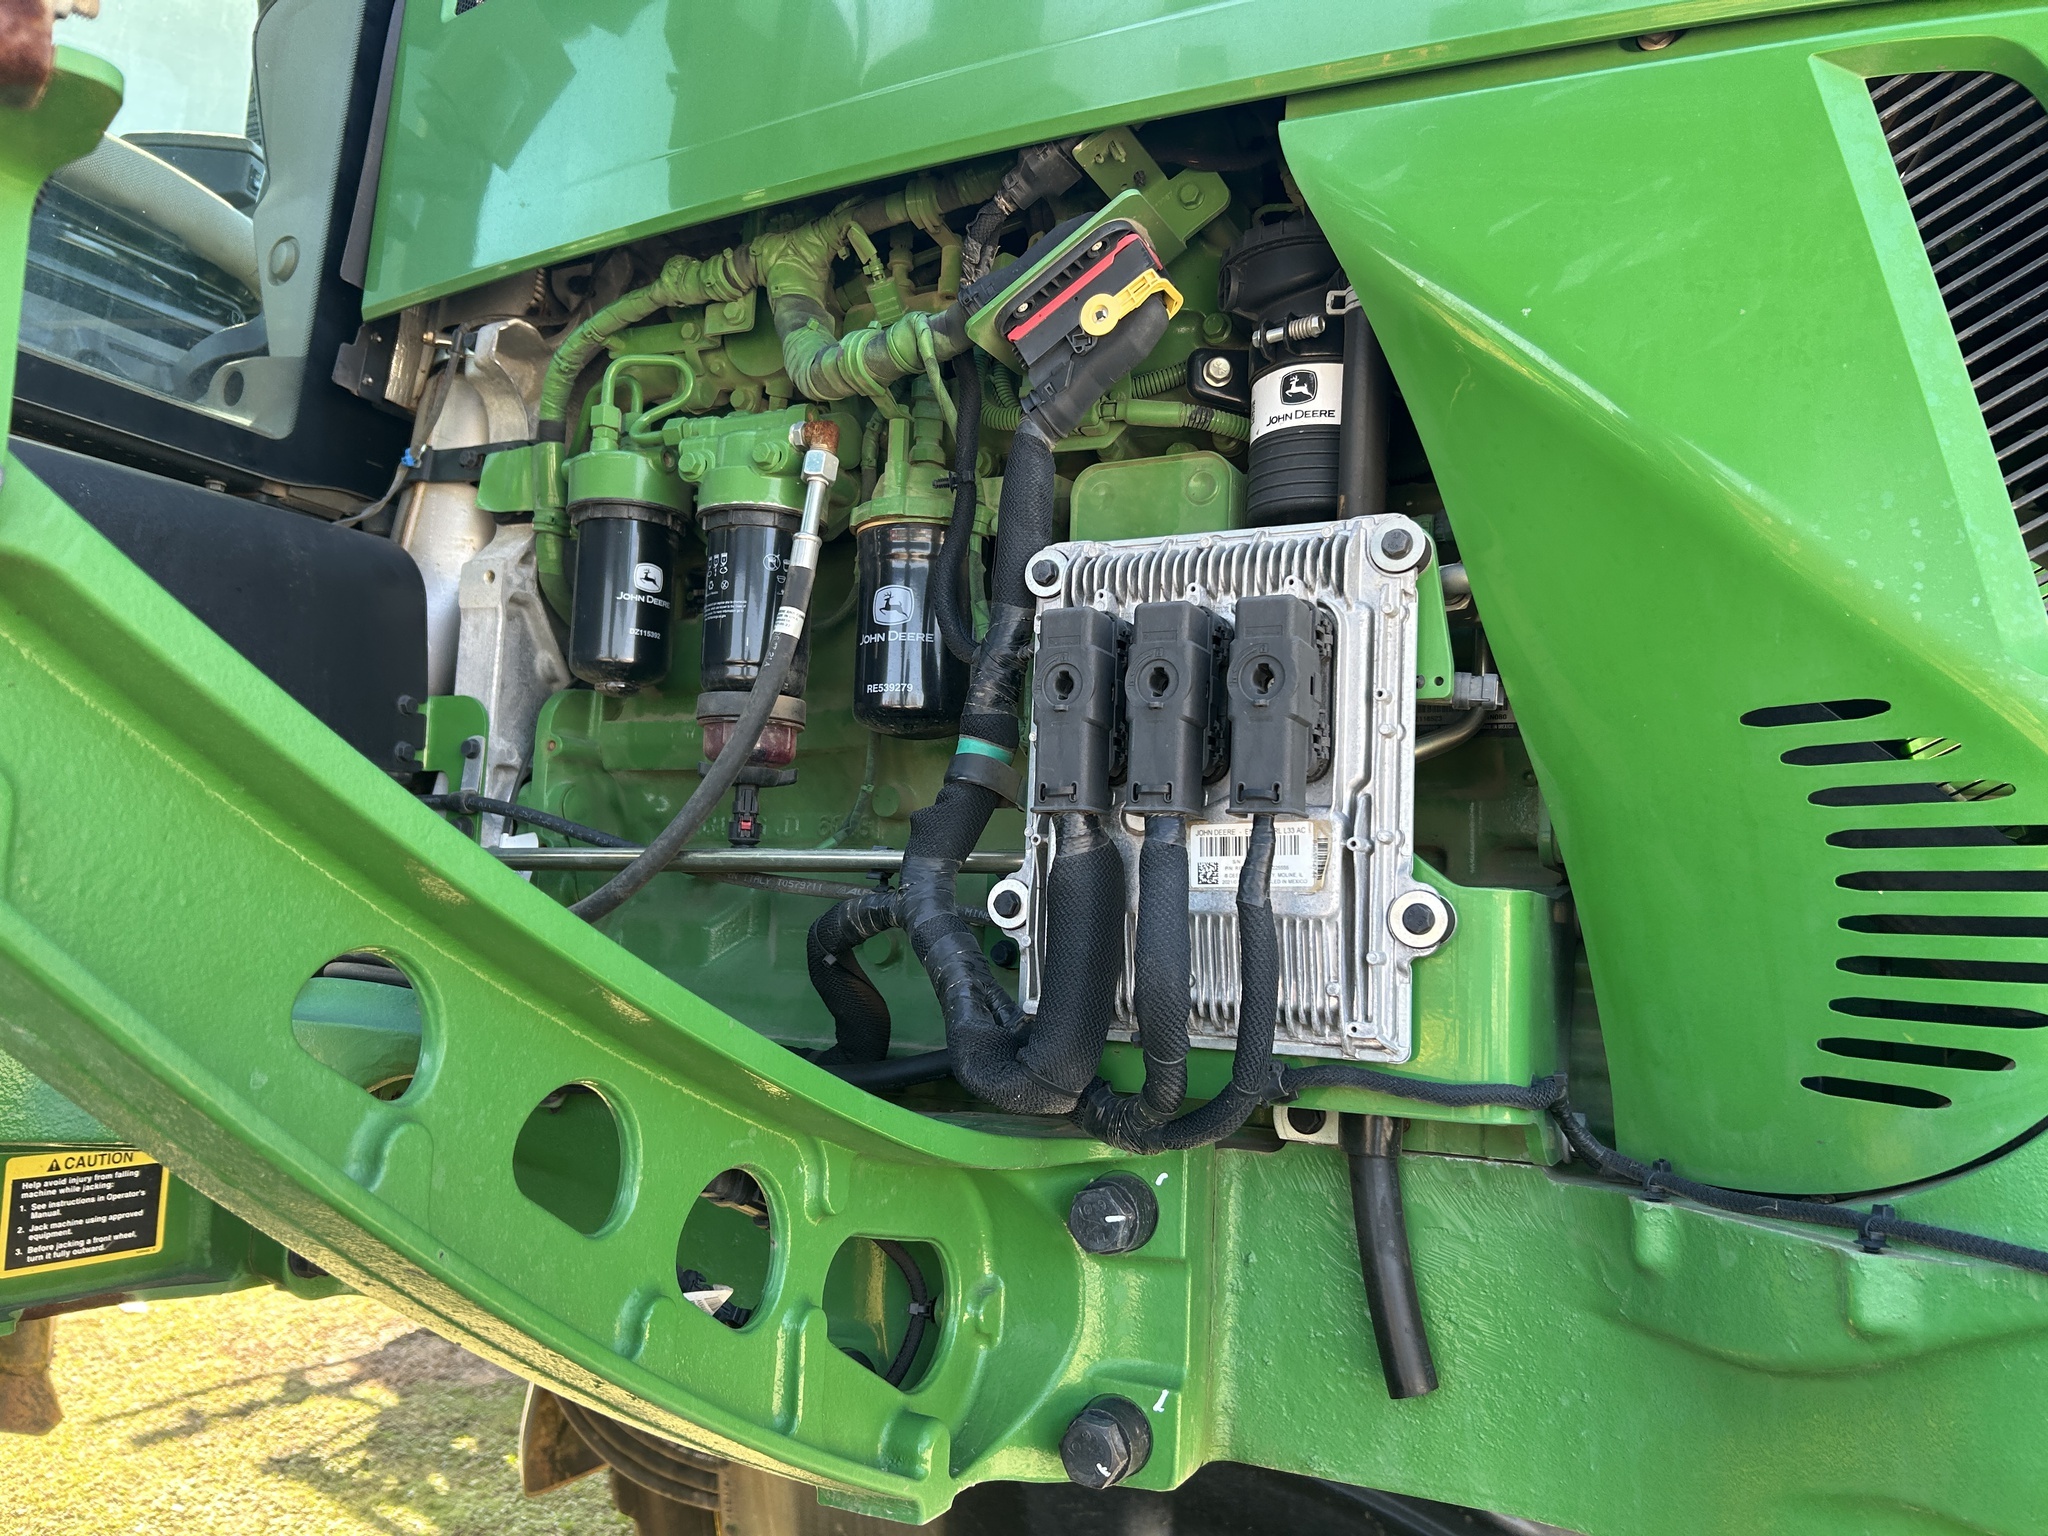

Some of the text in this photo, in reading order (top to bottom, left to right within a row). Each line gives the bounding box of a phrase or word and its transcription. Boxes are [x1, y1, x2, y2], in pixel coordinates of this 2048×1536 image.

[1266, 410, 1336, 427] JOHN DEERE
[616, 591, 670, 609] JOHN DEERE
[859, 631, 934, 646] JOHN DEERE
[867, 683, 913, 693] RE539279
[743, 875, 772, 885] ITALY
[64, 1152, 134, 1169] CAUTION
[22, 1181, 42, 1190] Help
[43, 1178, 67, 1187] avoid
[69, 1176, 92, 1185] injury
[114, 1170, 140, 1178] falling
[21, 1189, 57, 1199] machine
[59, 1186, 81, 1194] while
[31, 1203, 47, 1211] See
[48, 1197, 96, 1208] instructions
[106, 1189, 146, 1201] Operator's
[29, 1223, 48, 1232] Jack
[50, 1219, 84, 1229] machine
[85, 1216, 107, 1224] using
[108, 1209, 145, 1221] approved
[30, 1209, 62, 1219] Manual.
[28, 1228, 73, 1241] equipment.
[15, 1248, 23, 1256] 3.
[27, 1245, 54, 1254] Before
[55, 1240, 85, 1251] jacking
[93, 1235, 112, 1243] front
[27, 1254, 44, 1262] turn
[53, 1250, 71, 1258] fully
[72, 1243, 106, 1256] outward.
